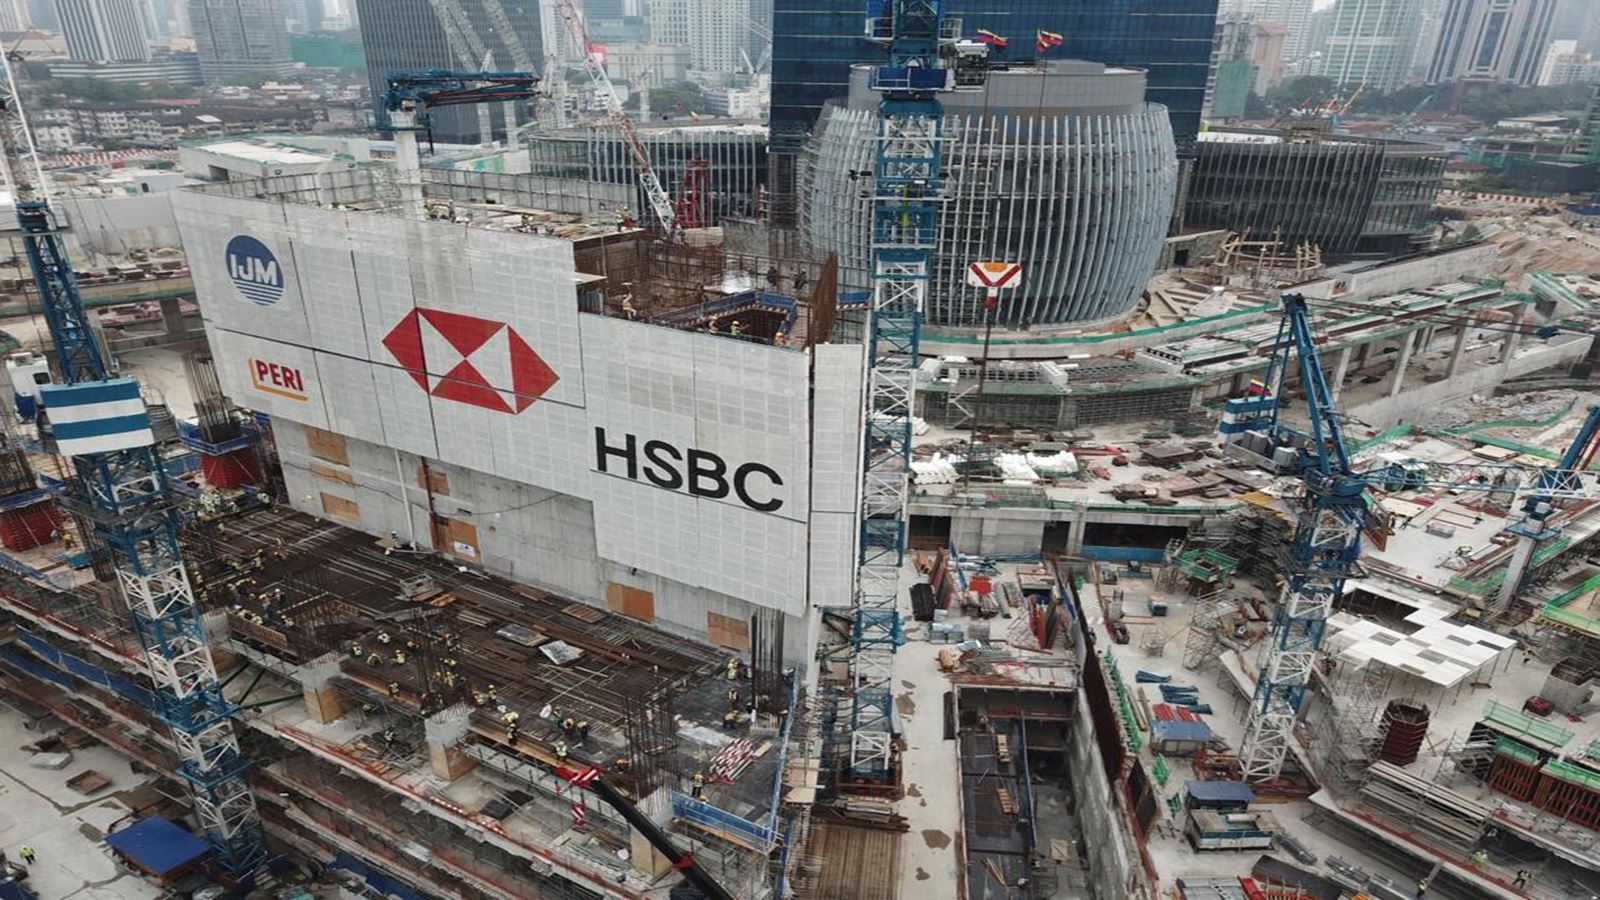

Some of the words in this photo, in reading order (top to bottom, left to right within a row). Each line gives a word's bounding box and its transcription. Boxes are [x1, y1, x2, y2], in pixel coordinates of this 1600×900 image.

[230, 254, 277, 285] IJM
[256, 360, 304, 391] PERI
[595, 426, 784, 512] HSBC
